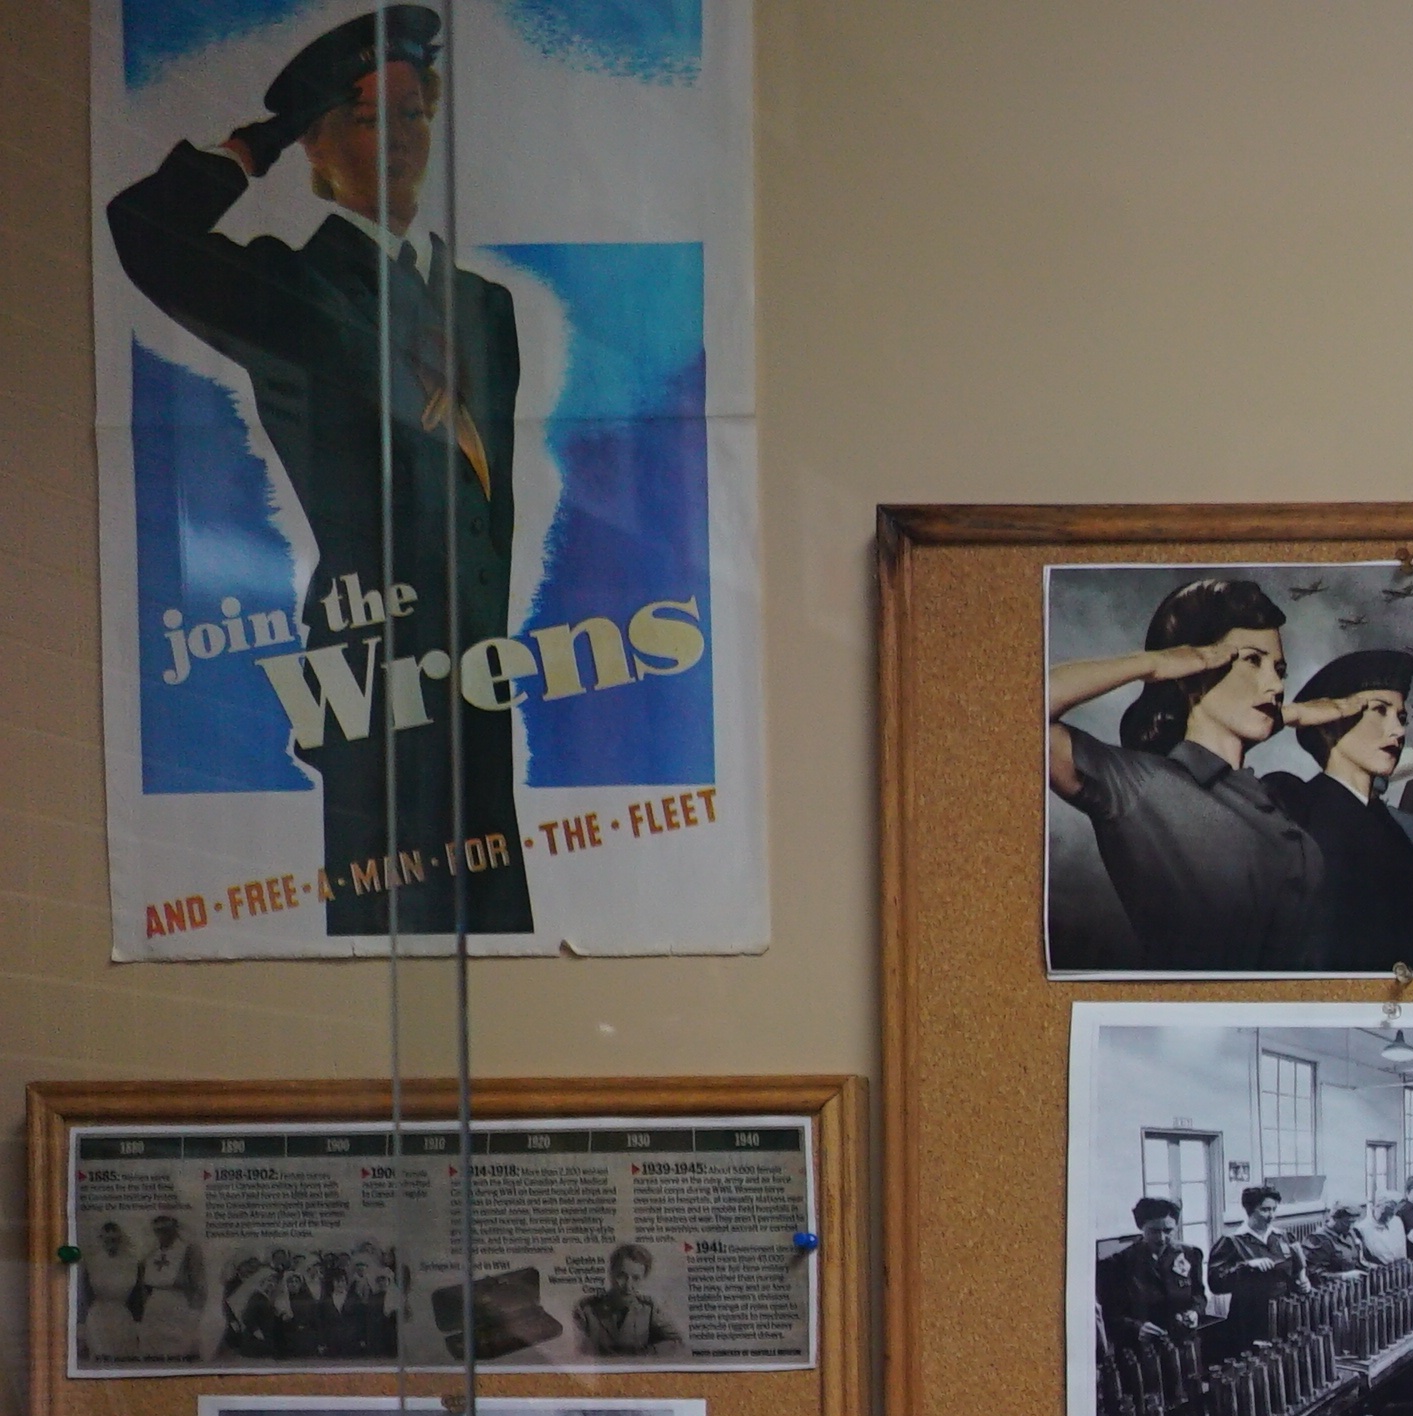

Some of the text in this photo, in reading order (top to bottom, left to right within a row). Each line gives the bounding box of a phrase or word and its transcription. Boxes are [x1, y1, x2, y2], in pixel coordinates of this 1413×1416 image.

[161, 596, 294, 687] join
[321, 573, 417, 633] the
[255, 595, 706, 751] Wrens
[146, 787, 717, 939] AND FREE A MAN FOR THE FLEET
[626, 1133, 651, 1148] 1930
[734, 1132, 760, 1147] 1940
